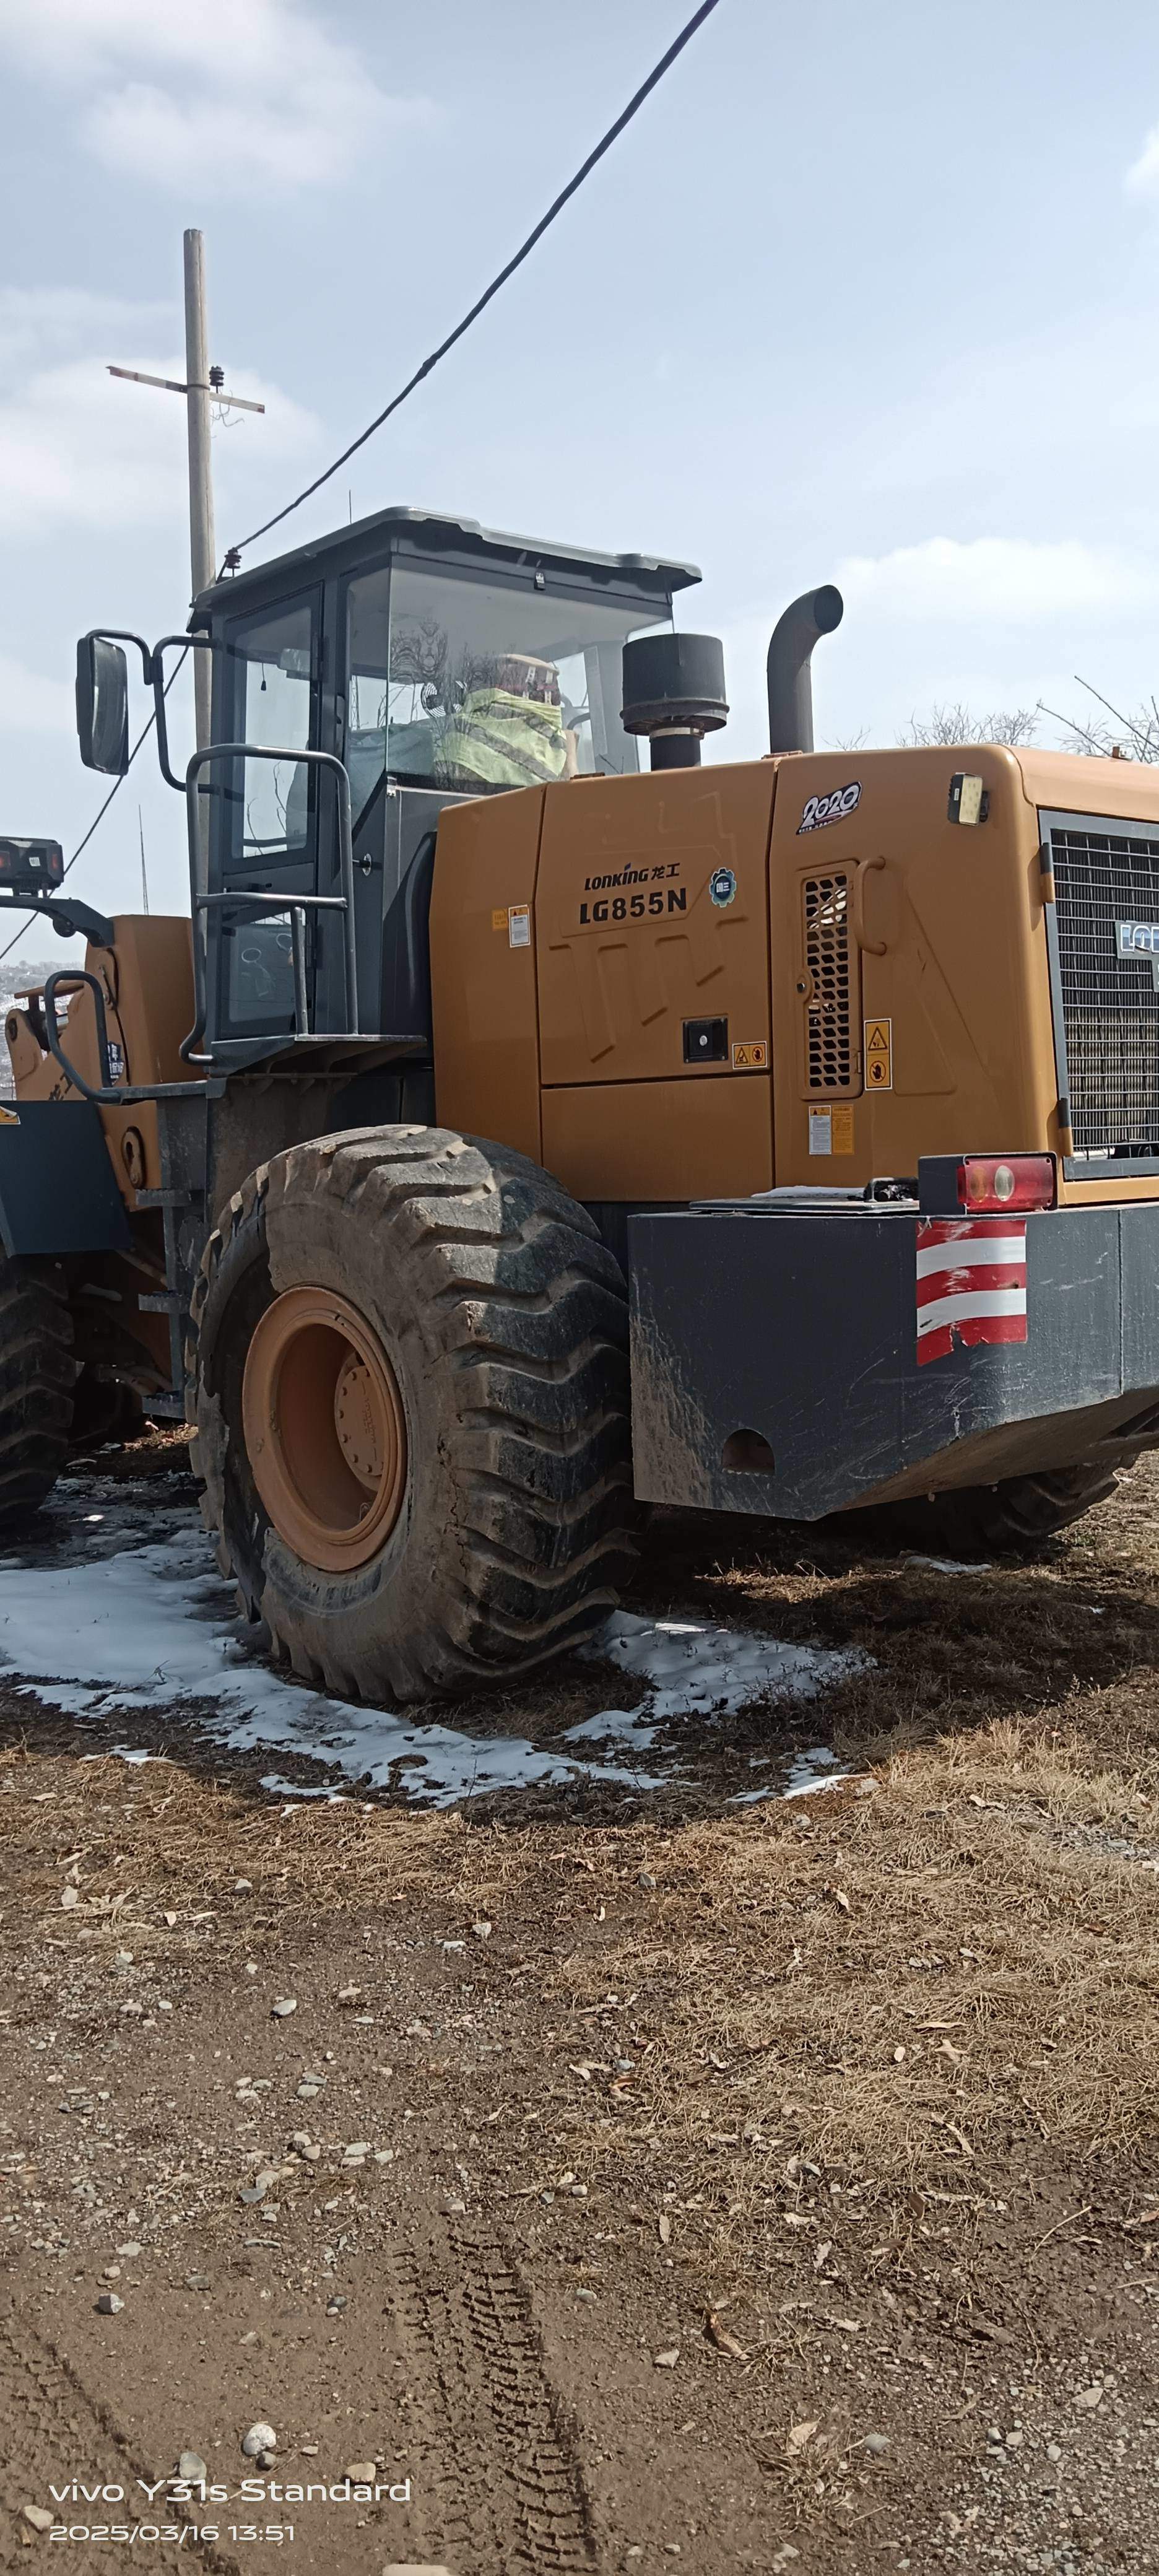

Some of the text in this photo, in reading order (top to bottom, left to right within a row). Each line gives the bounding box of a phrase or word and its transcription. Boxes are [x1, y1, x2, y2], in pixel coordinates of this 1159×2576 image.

[801, 785, 859, 829] 2020
[651, 863, 680, 881] 龙工
[580, 887, 687, 925] LG855N
